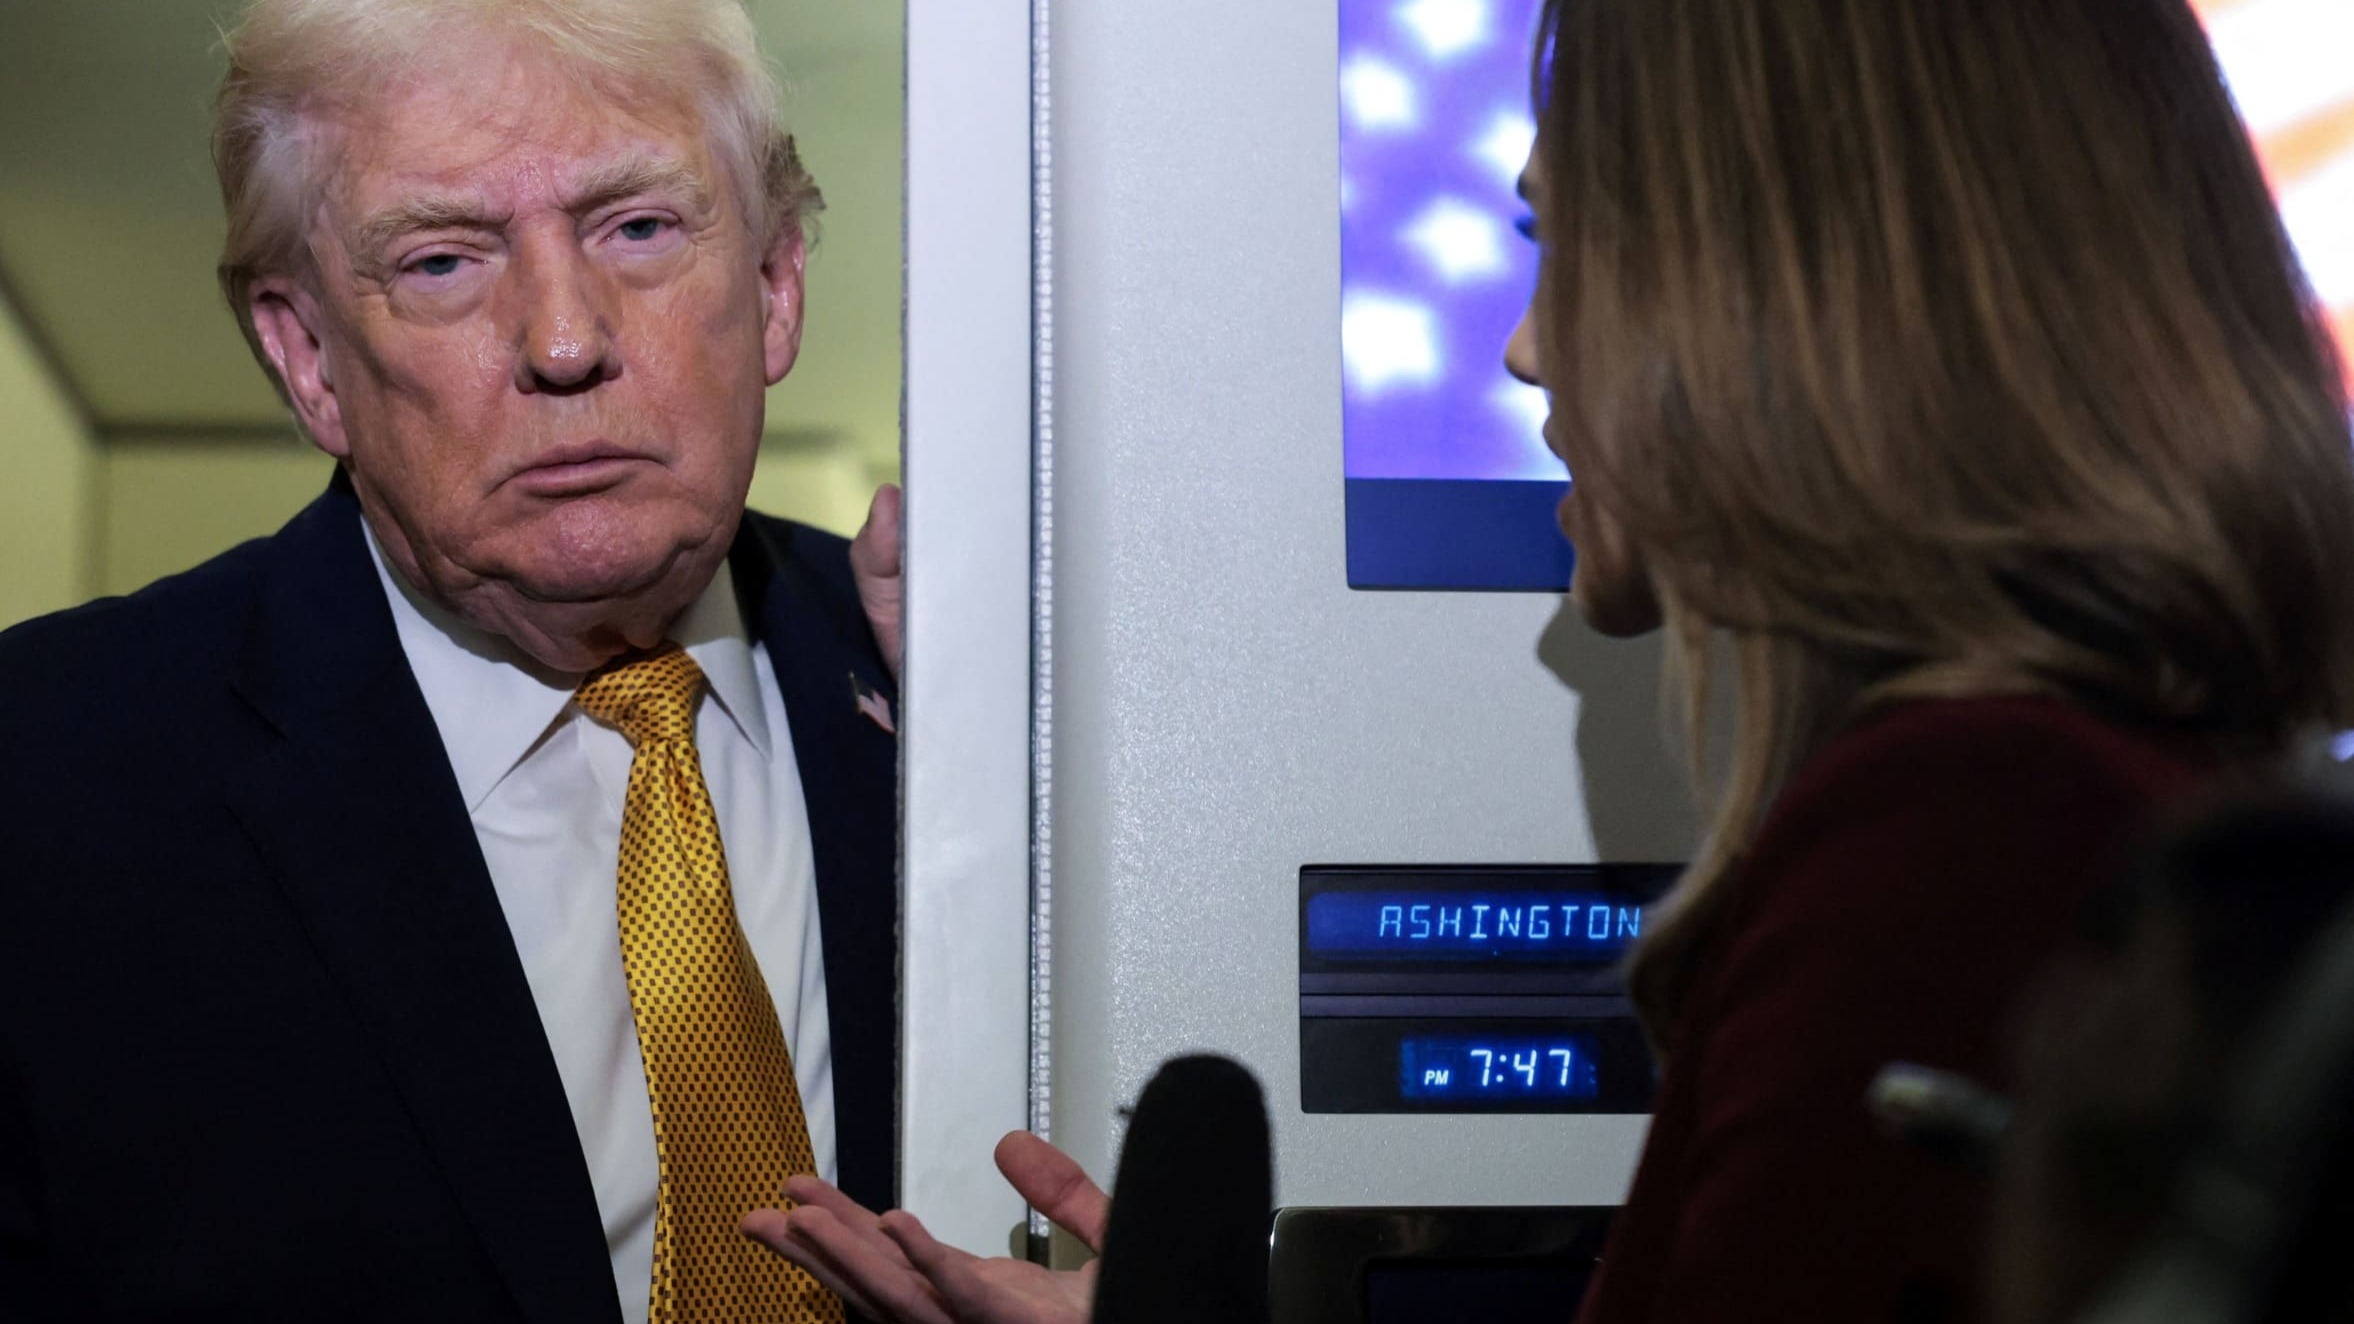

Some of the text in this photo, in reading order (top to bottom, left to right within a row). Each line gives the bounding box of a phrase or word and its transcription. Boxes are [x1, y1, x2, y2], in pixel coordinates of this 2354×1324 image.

[1378, 904, 1640, 939] ASHINGTON
[1424, 1048, 1571, 1087] PM 7:47
